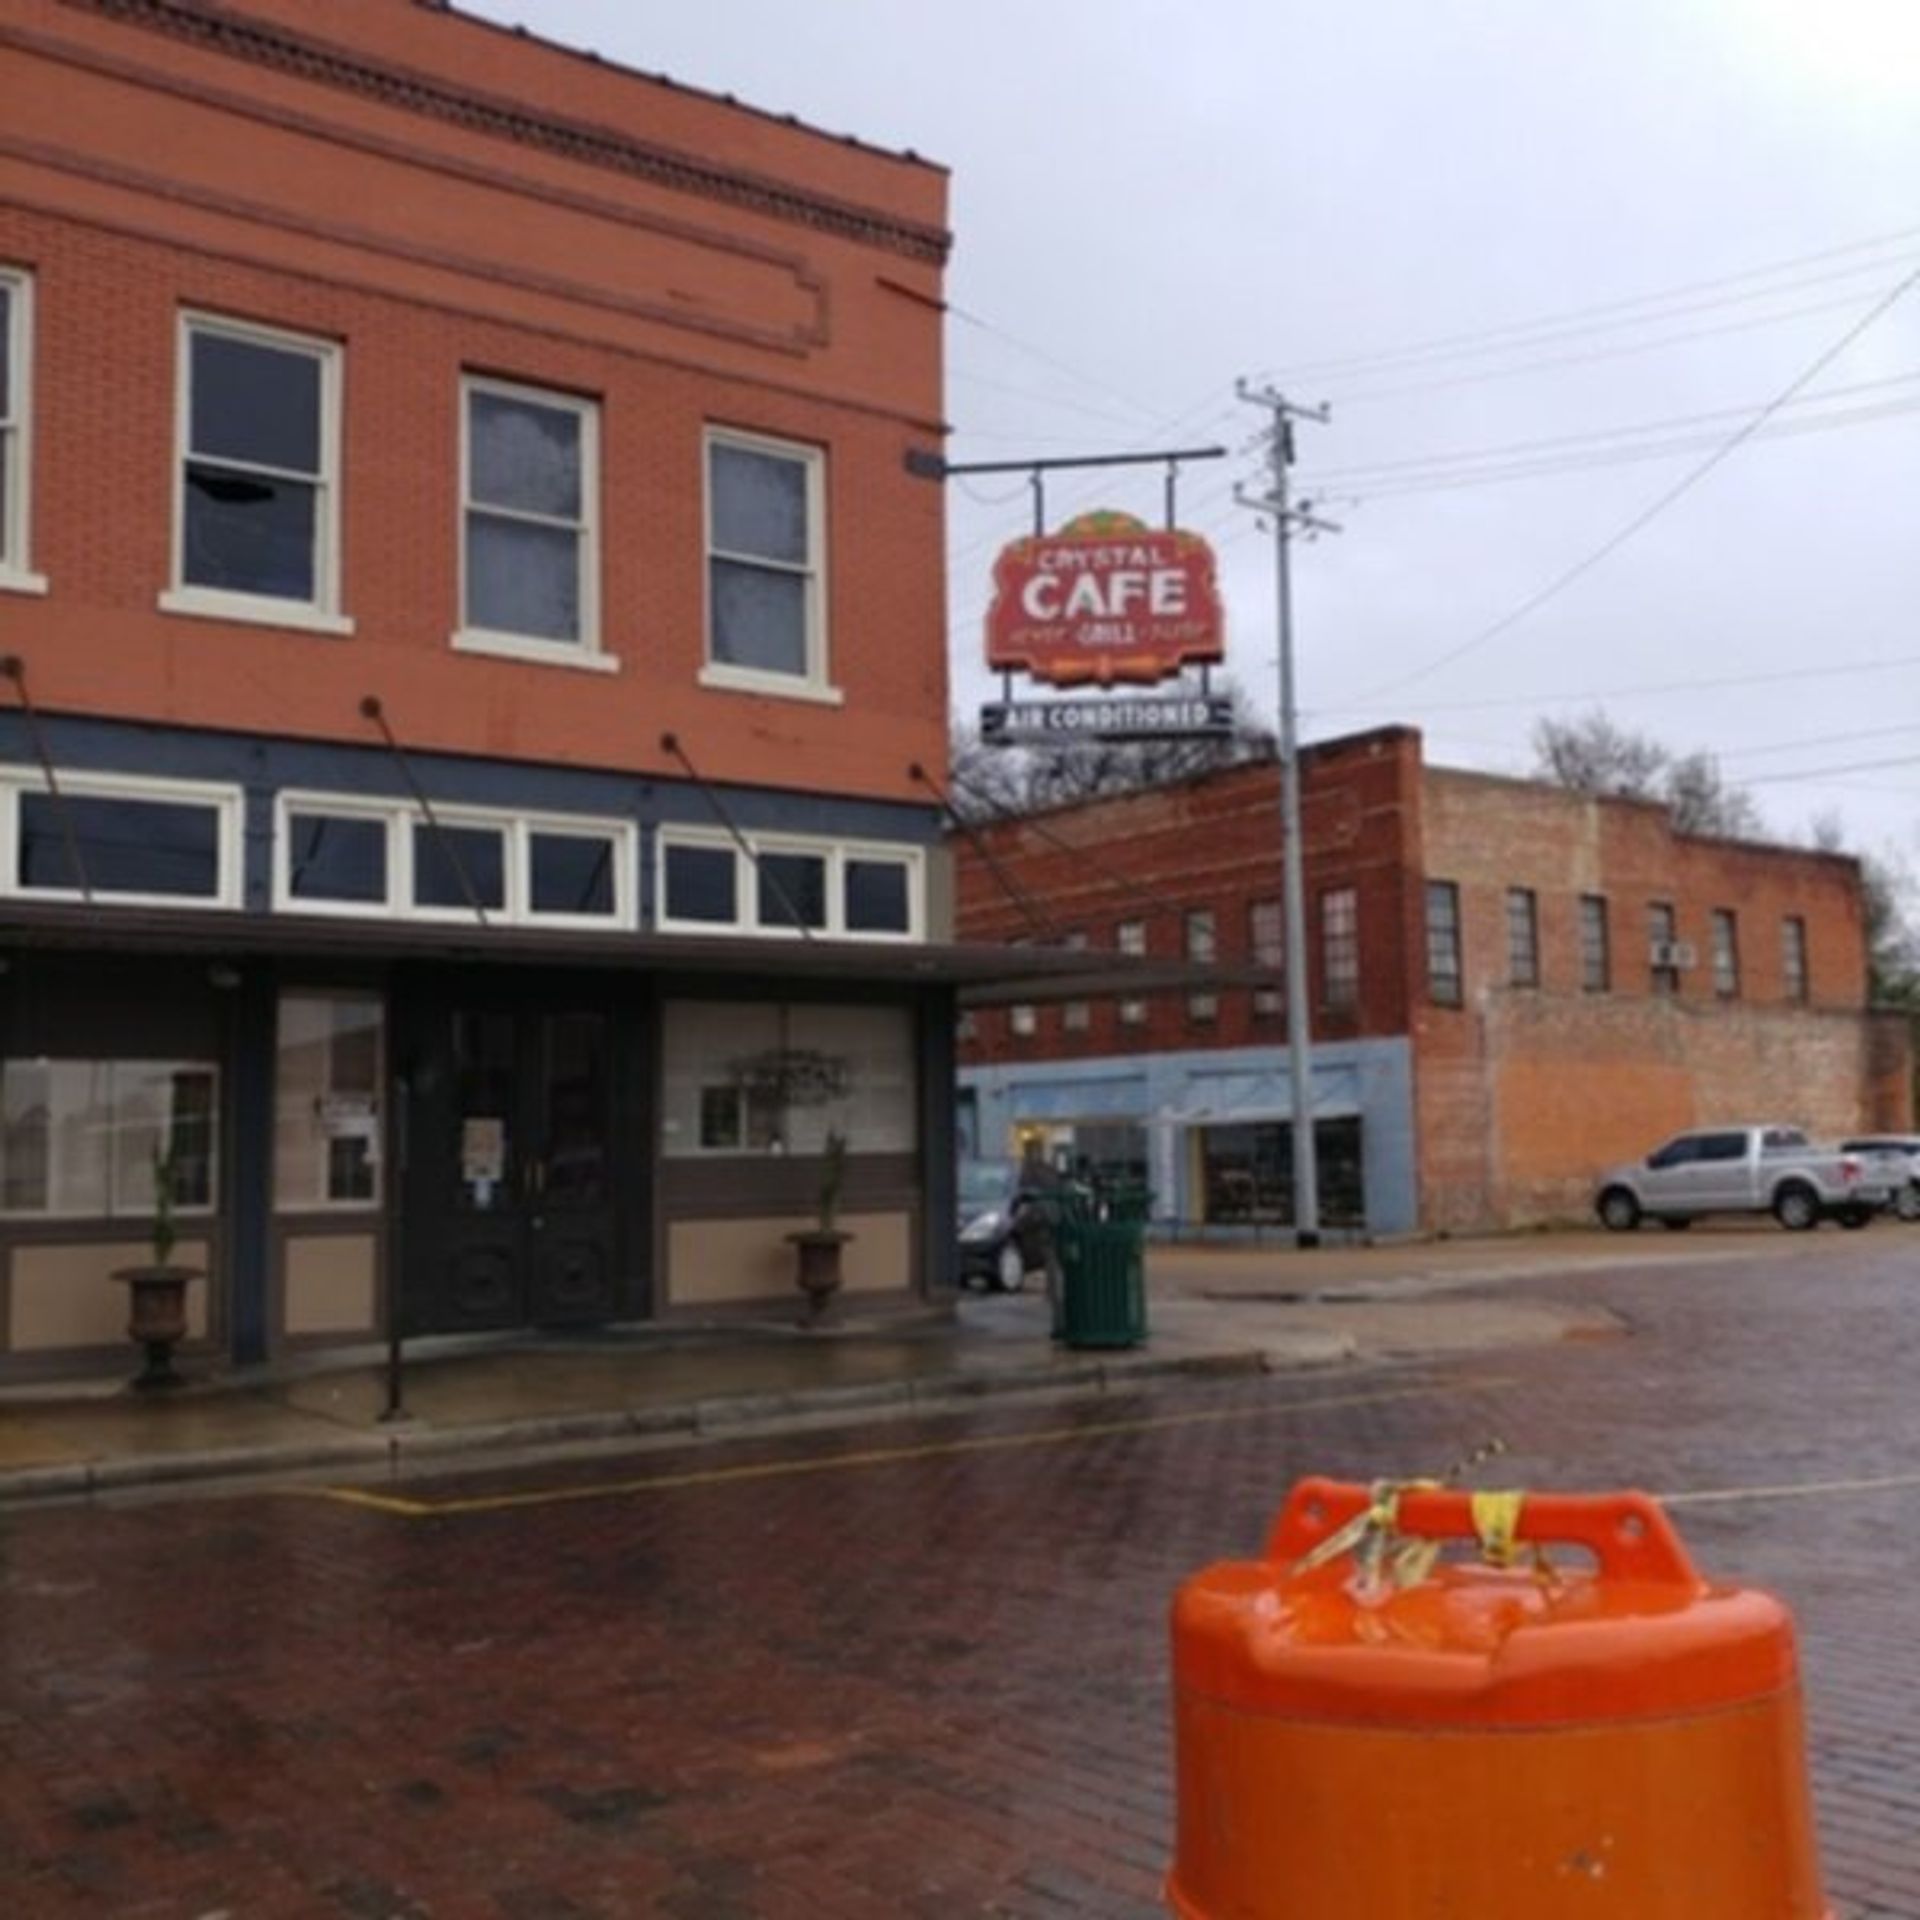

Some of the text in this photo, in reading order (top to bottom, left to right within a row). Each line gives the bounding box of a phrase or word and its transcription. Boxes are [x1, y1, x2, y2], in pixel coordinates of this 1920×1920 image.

[1038, 546, 1168, 570] CRYSTAL
[1022, 568, 1188, 620] CAFE
[1004, 702, 1209, 729] AIR CONDITIONED
